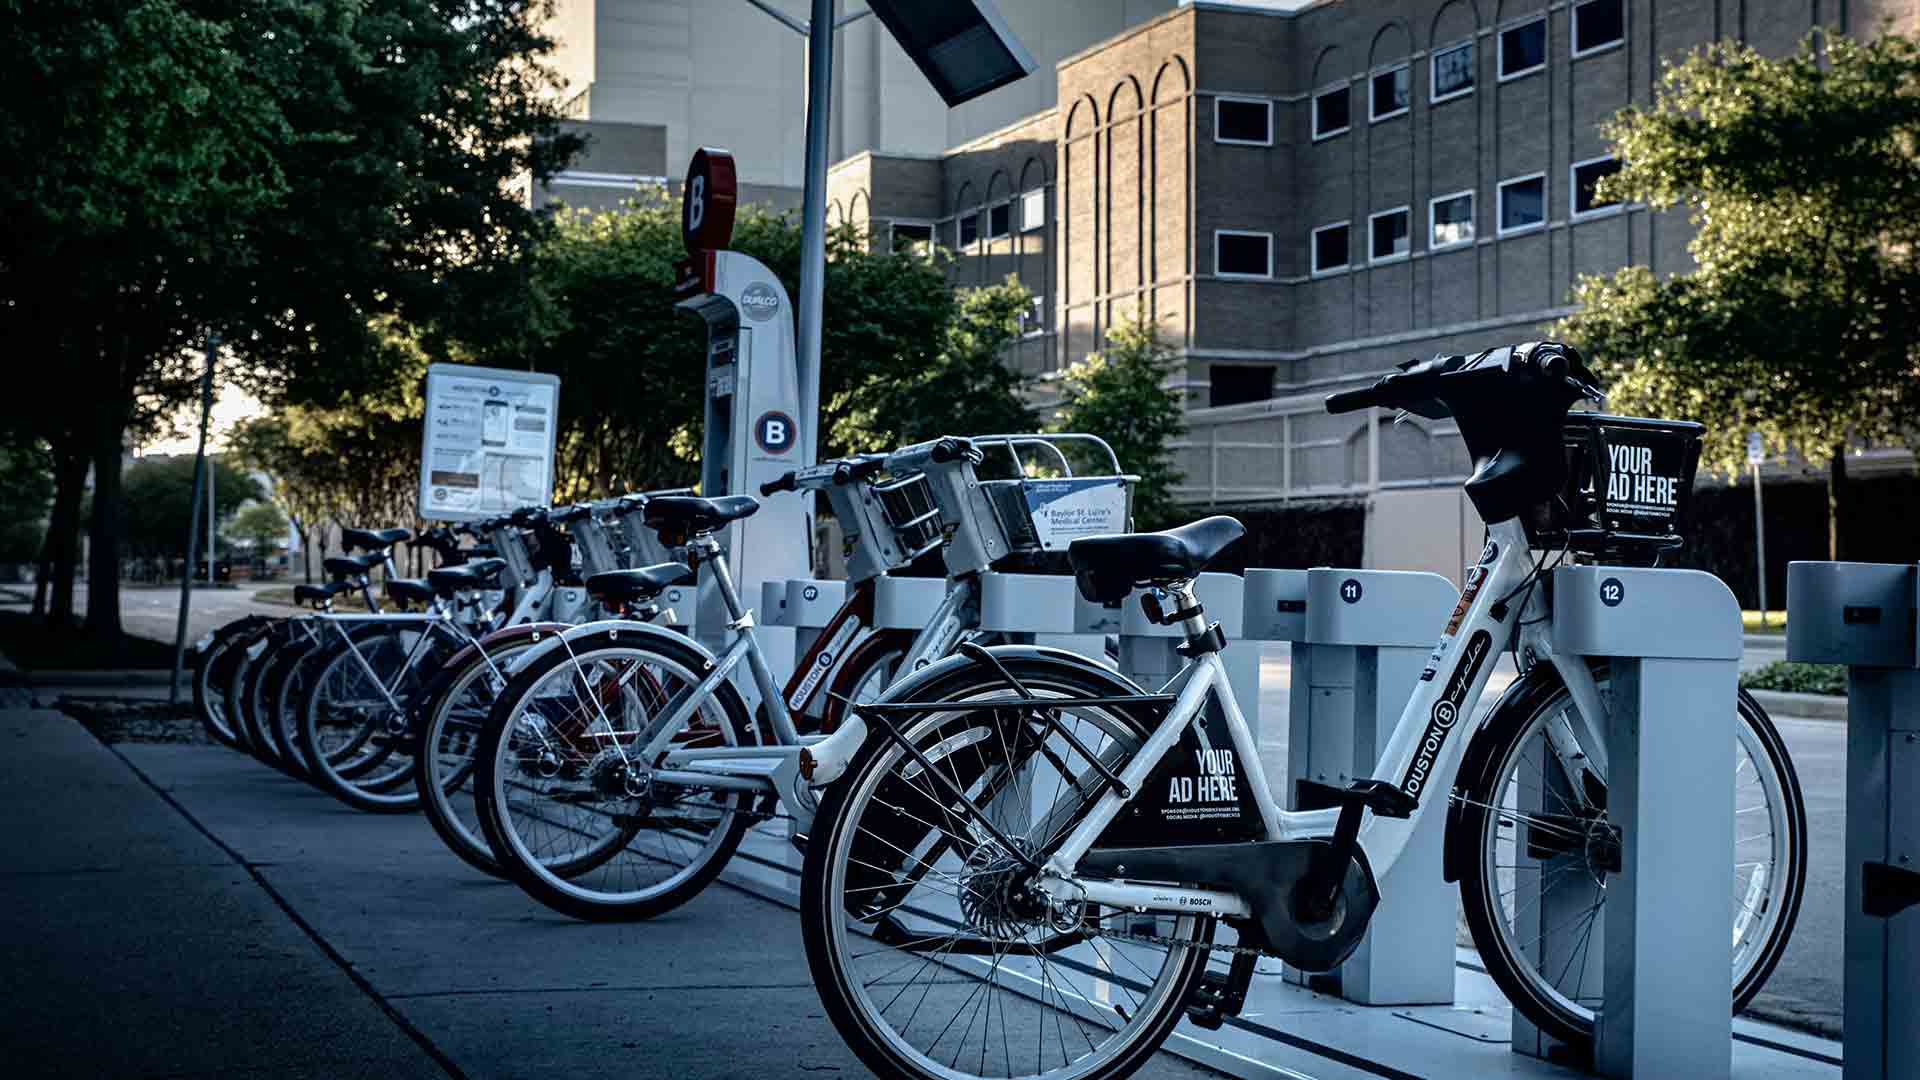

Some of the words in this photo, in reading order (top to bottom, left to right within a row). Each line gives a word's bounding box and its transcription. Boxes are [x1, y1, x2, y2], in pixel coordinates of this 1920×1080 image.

[689, 175, 705, 231] B
[766, 420, 785, 444] B
[1607, 444, 1652, 475] YOUR
[1606, 472, 1630, 501] AD
[1634, 474, 1678, 505] HERE
[1050, 510, 1074, 519] Baylor
[805, 589, 816, 598] 07
[1345, 585, 1356, 598] 11
[1604, 585, 1619, 600] 12
[791, 665, 823, 707] HOUSTON
[1438, 706, 1453, 723] B
[1195, 749, 1235, 775] YOUR
[1169, 776, 1193, 803] AD
[1197, 775, 1239, 802] HERE
[1189, 897, 1212, 906] BOSCH
